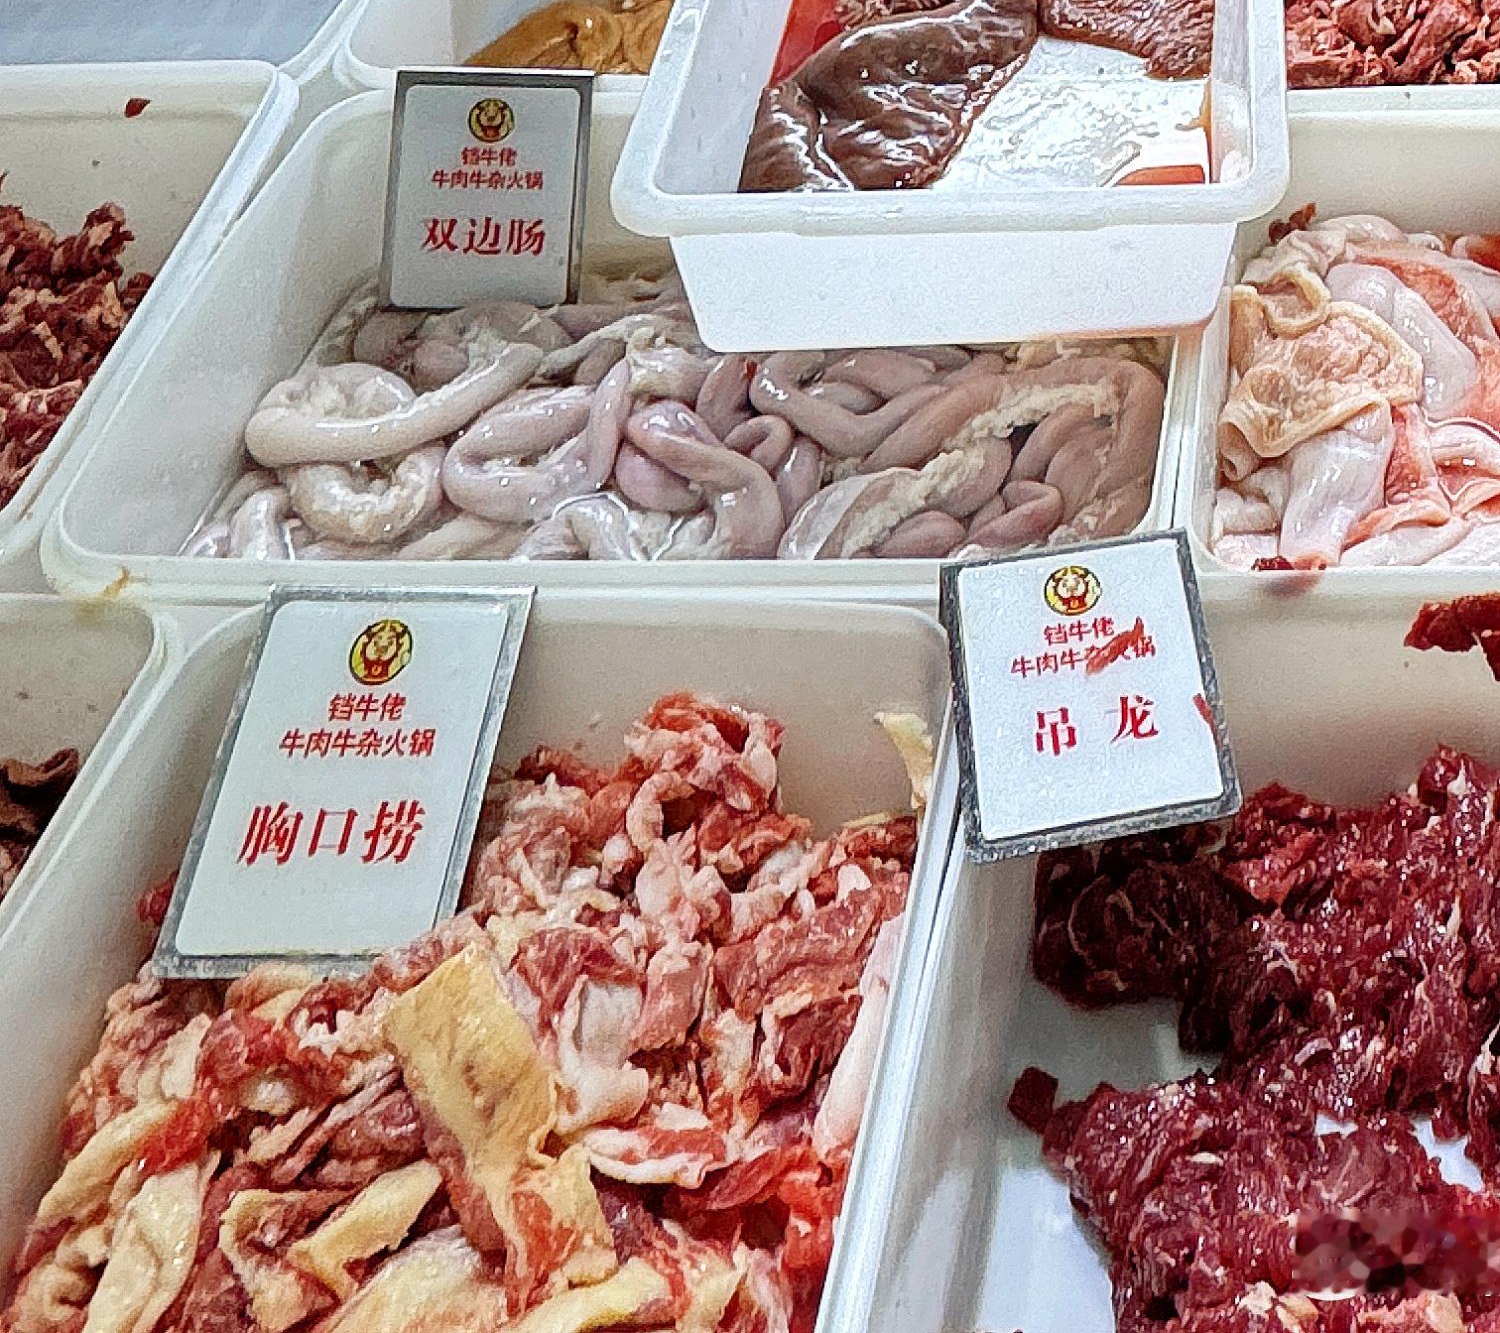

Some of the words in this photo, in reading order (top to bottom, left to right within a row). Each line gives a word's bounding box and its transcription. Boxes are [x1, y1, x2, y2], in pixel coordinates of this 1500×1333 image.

[420, 215, 546, 256] 双边肠
[328, 692, 406, 722] 铛牛佬
[1034, 694, 1159, 757] 吊龙
[278, 728, 436, 759] 牛肉牛杂火锅
[236, 798, 426, 866] 胸口捞
